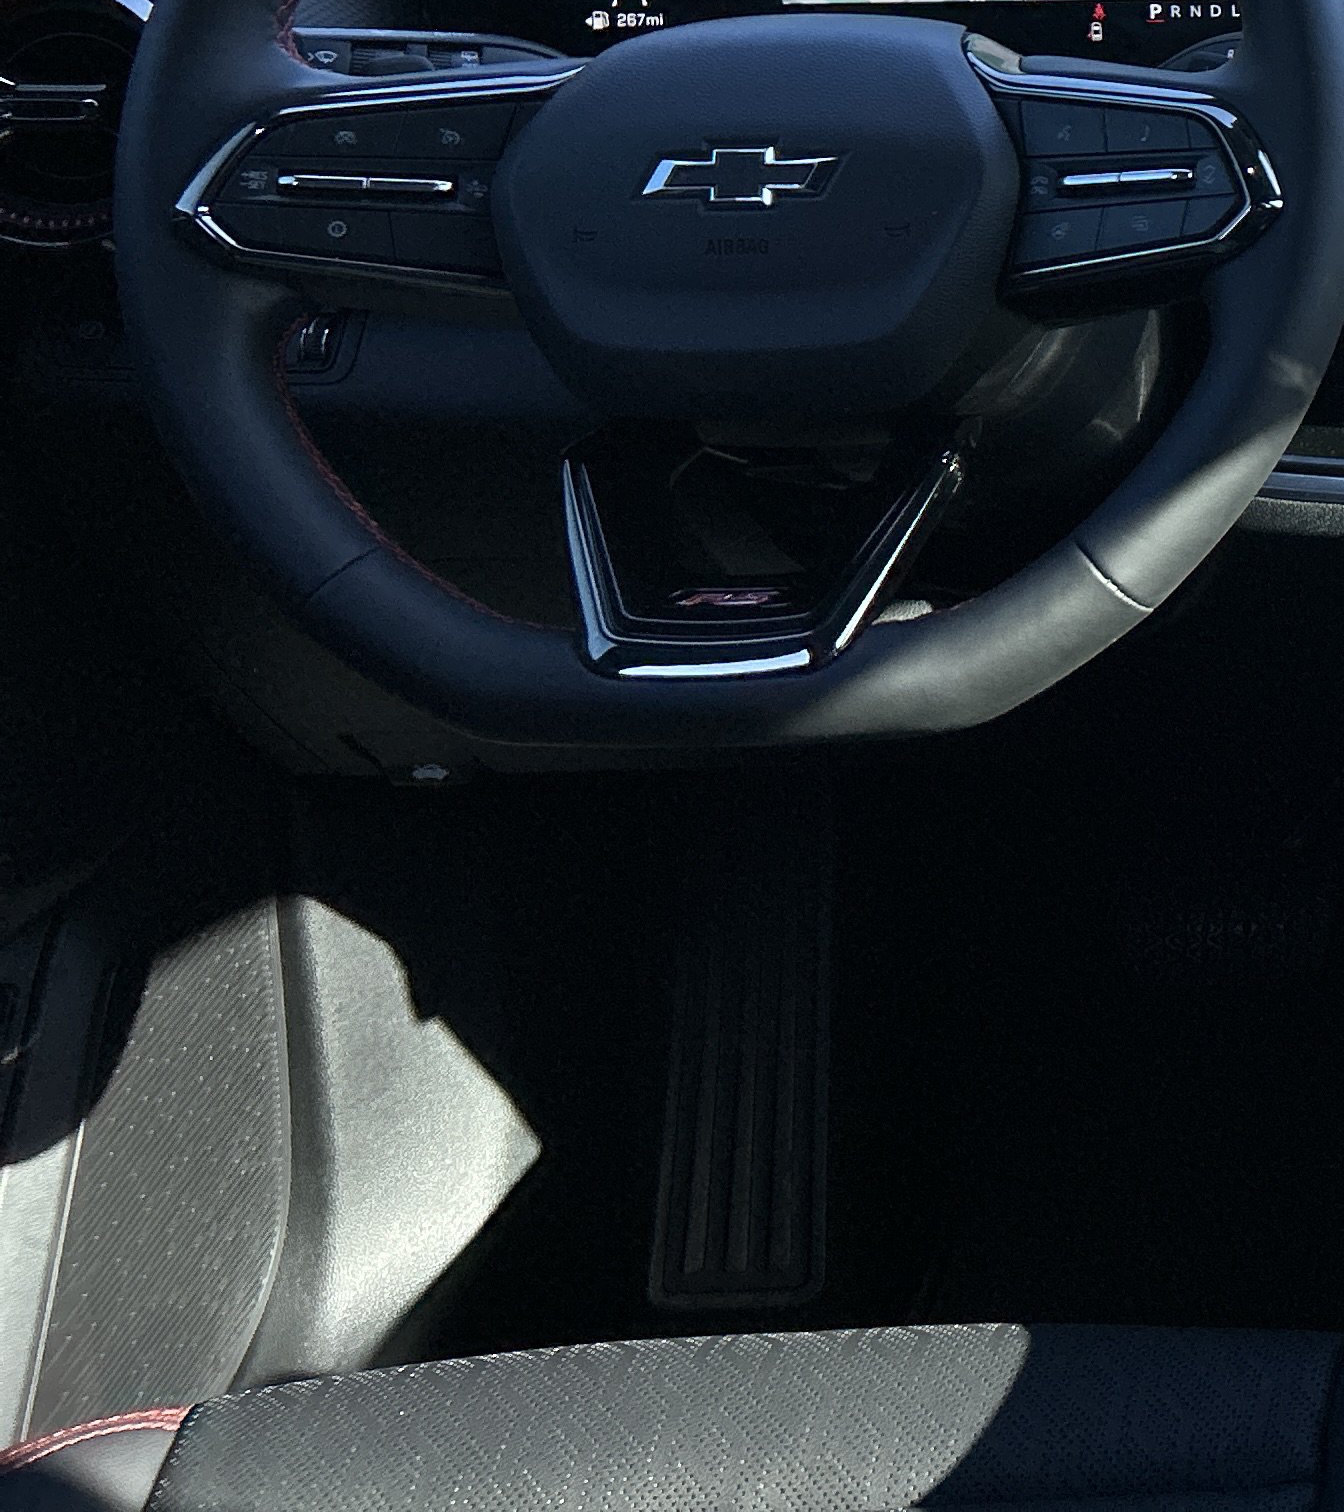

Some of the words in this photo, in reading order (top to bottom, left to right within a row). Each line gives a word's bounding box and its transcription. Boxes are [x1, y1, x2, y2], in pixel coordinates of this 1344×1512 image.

[617, 12, 664, 27] 267mi
[1149, 3, 1163, 20] P
[1170, 4, 1182, 18] R
[1190, 4, 1201, 18] N
[1210, 4, 1222, 17] D
[1231, 4, 1241, 18] L
